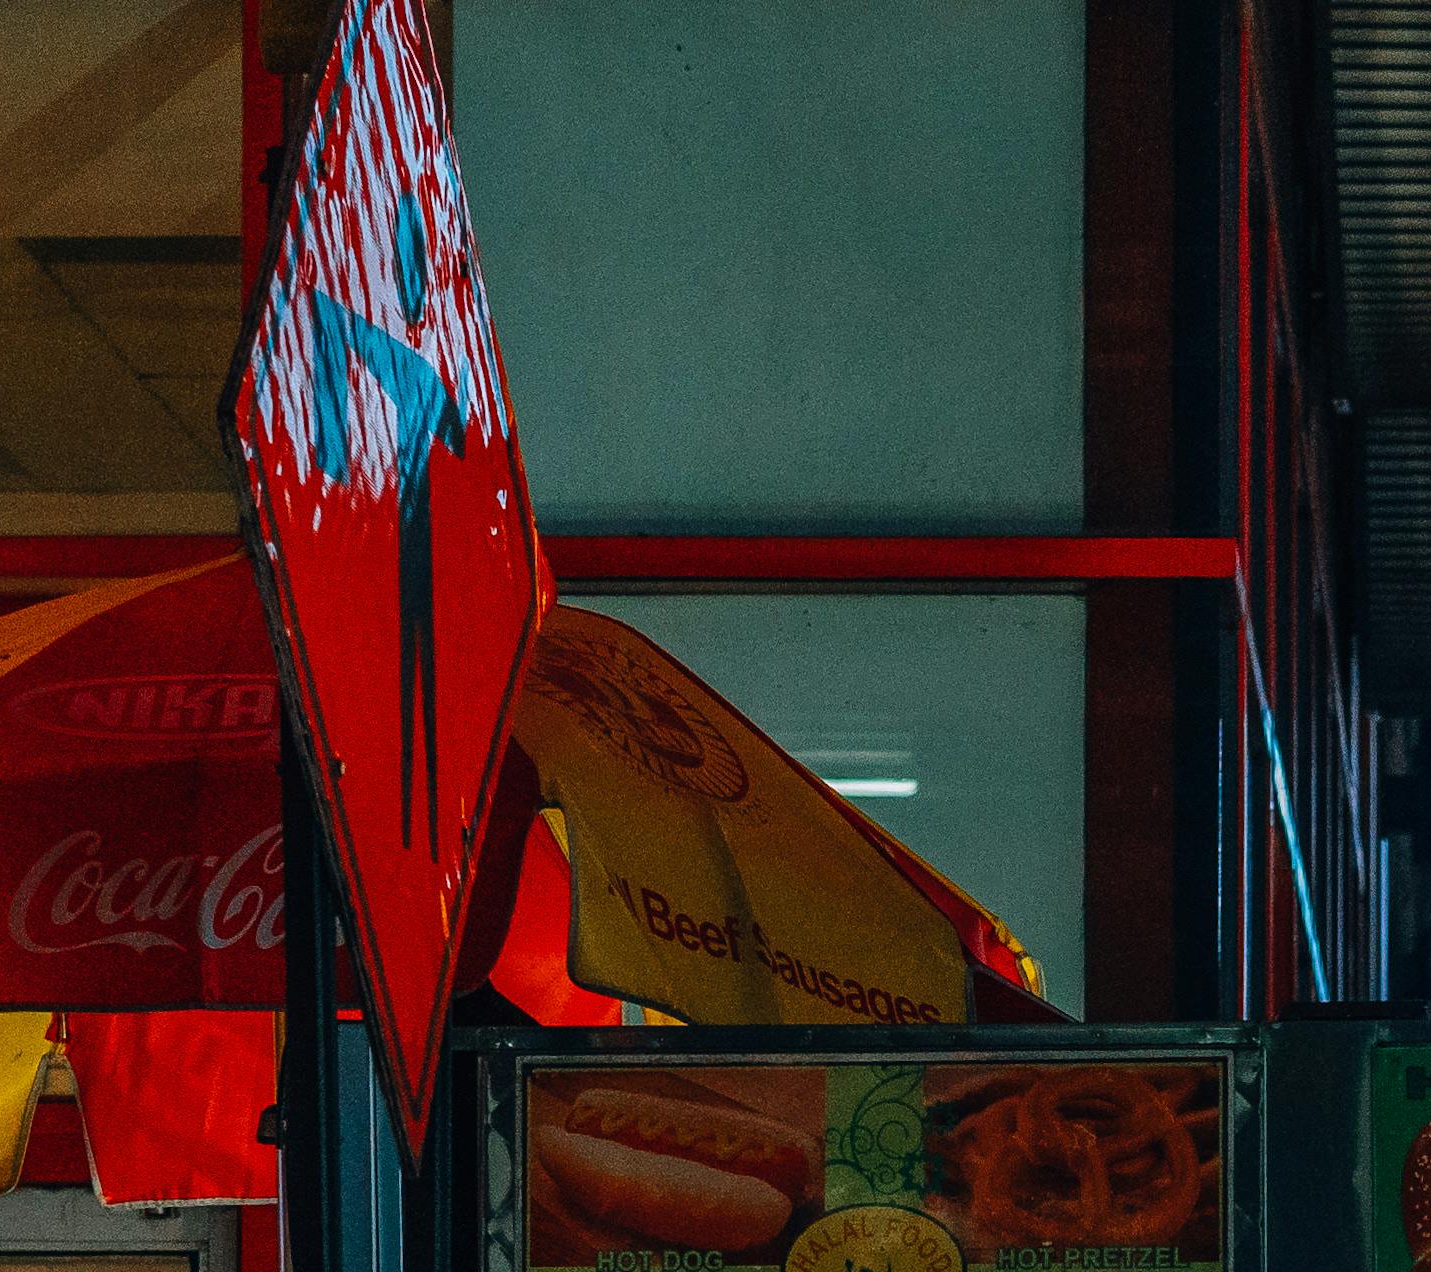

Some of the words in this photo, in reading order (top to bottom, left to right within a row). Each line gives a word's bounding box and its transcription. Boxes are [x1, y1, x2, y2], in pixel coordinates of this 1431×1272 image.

[69, 682, 281, 731] NIKA
[641, 886, 742, 962] Beef
[595, 1249, 653, 1272] HOT
[996, 1248, 1051, 1272] HOT
[1063, 1246, 1191, 1270] PRETZEL
